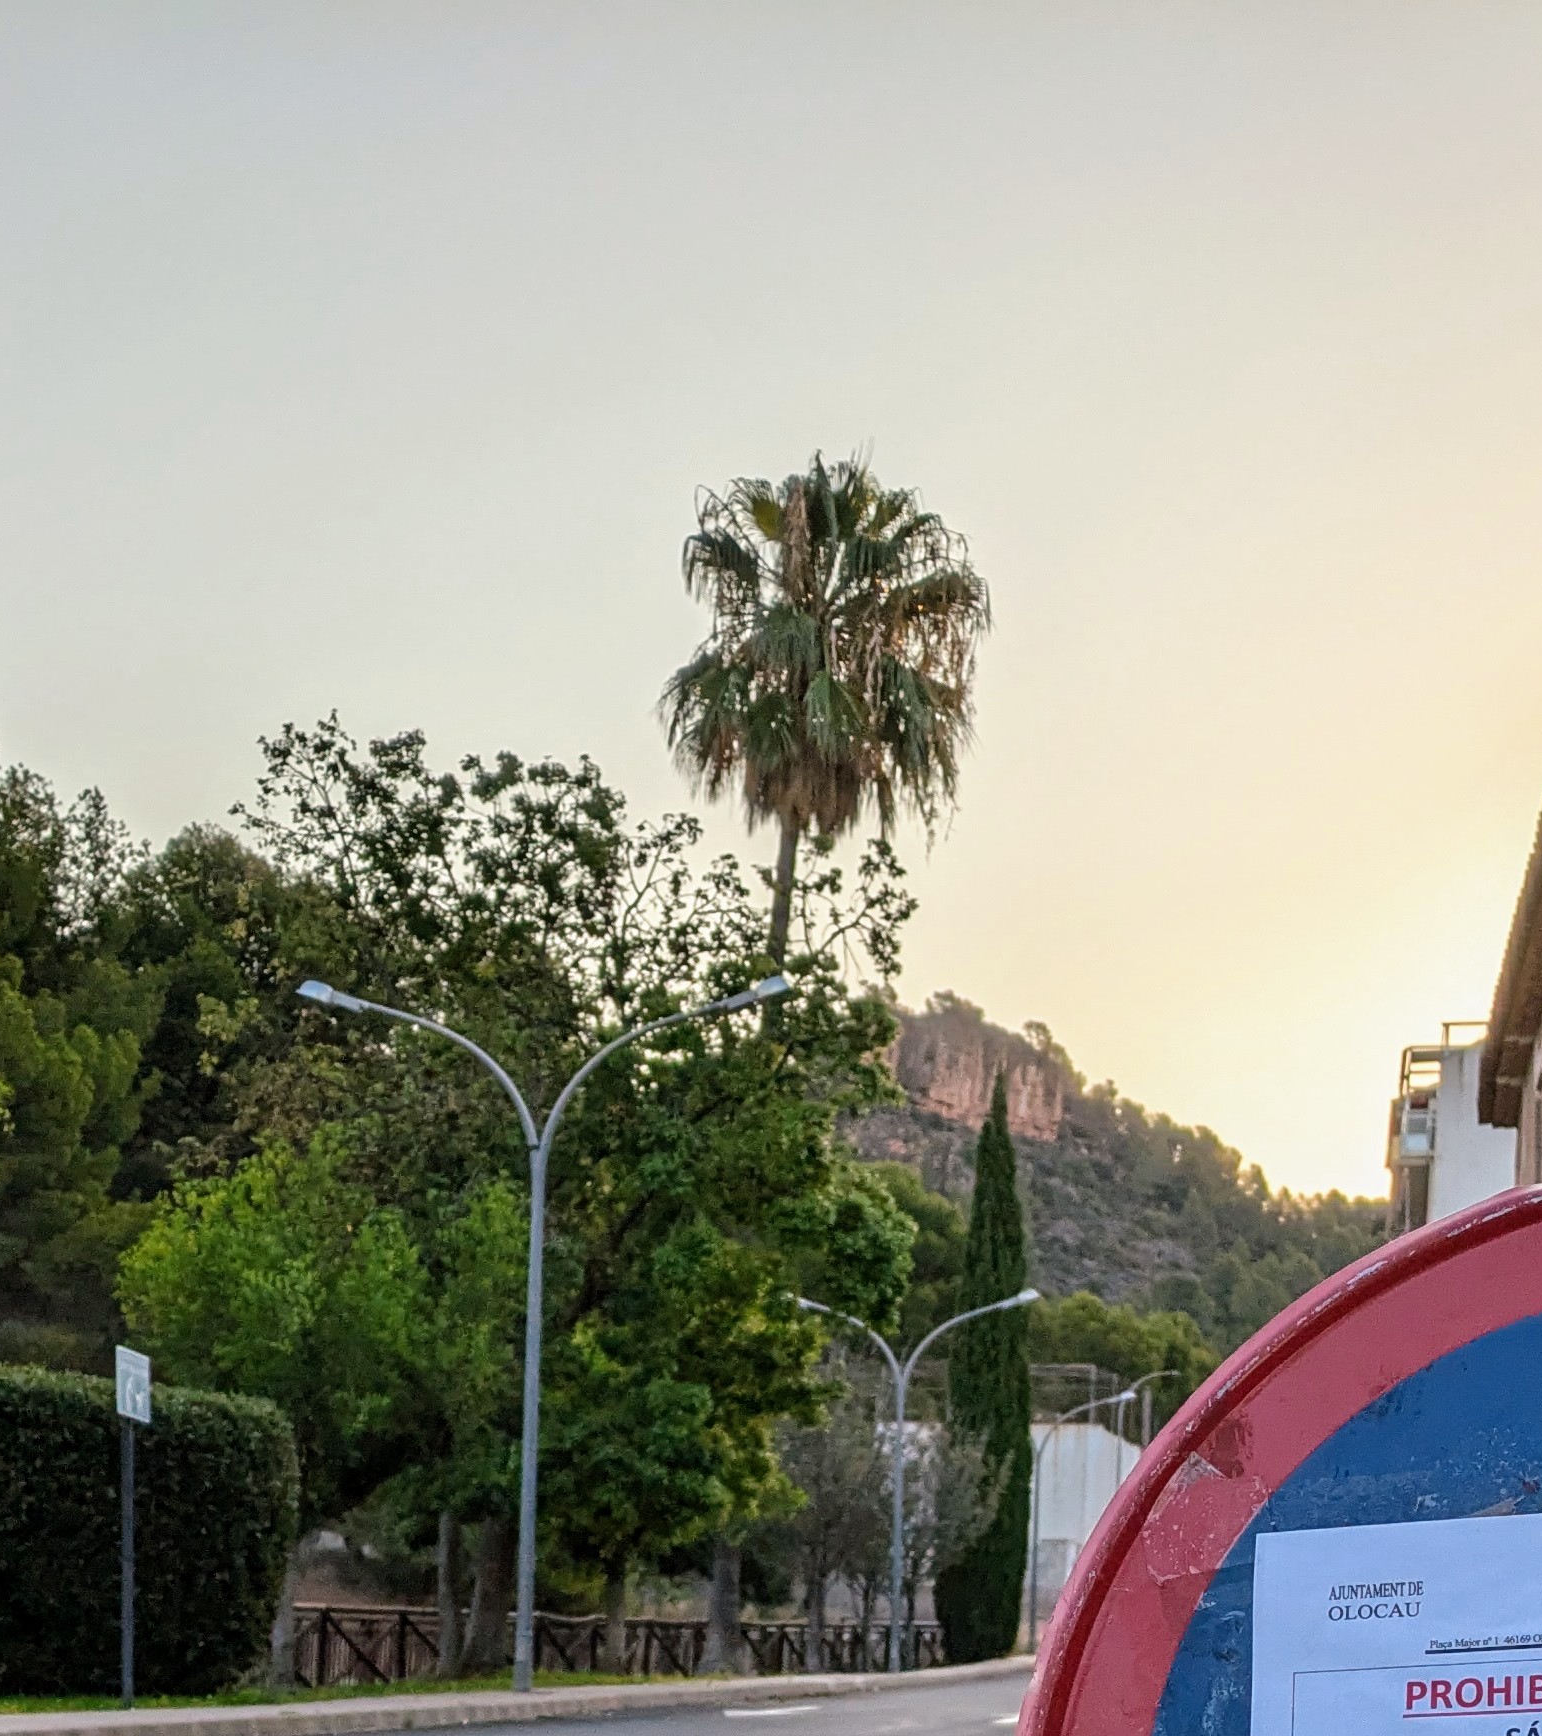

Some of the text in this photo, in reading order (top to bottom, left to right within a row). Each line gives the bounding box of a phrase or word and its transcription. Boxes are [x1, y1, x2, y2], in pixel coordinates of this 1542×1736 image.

[1328, 1580, 1424, 1601] AJUNTAMENT DE
[1328, 1601, 1421, 1621] OLOCAU
[1454, 1637, 1481, 1650] Major
[1504, 1634, 1531, 1644] 46169
